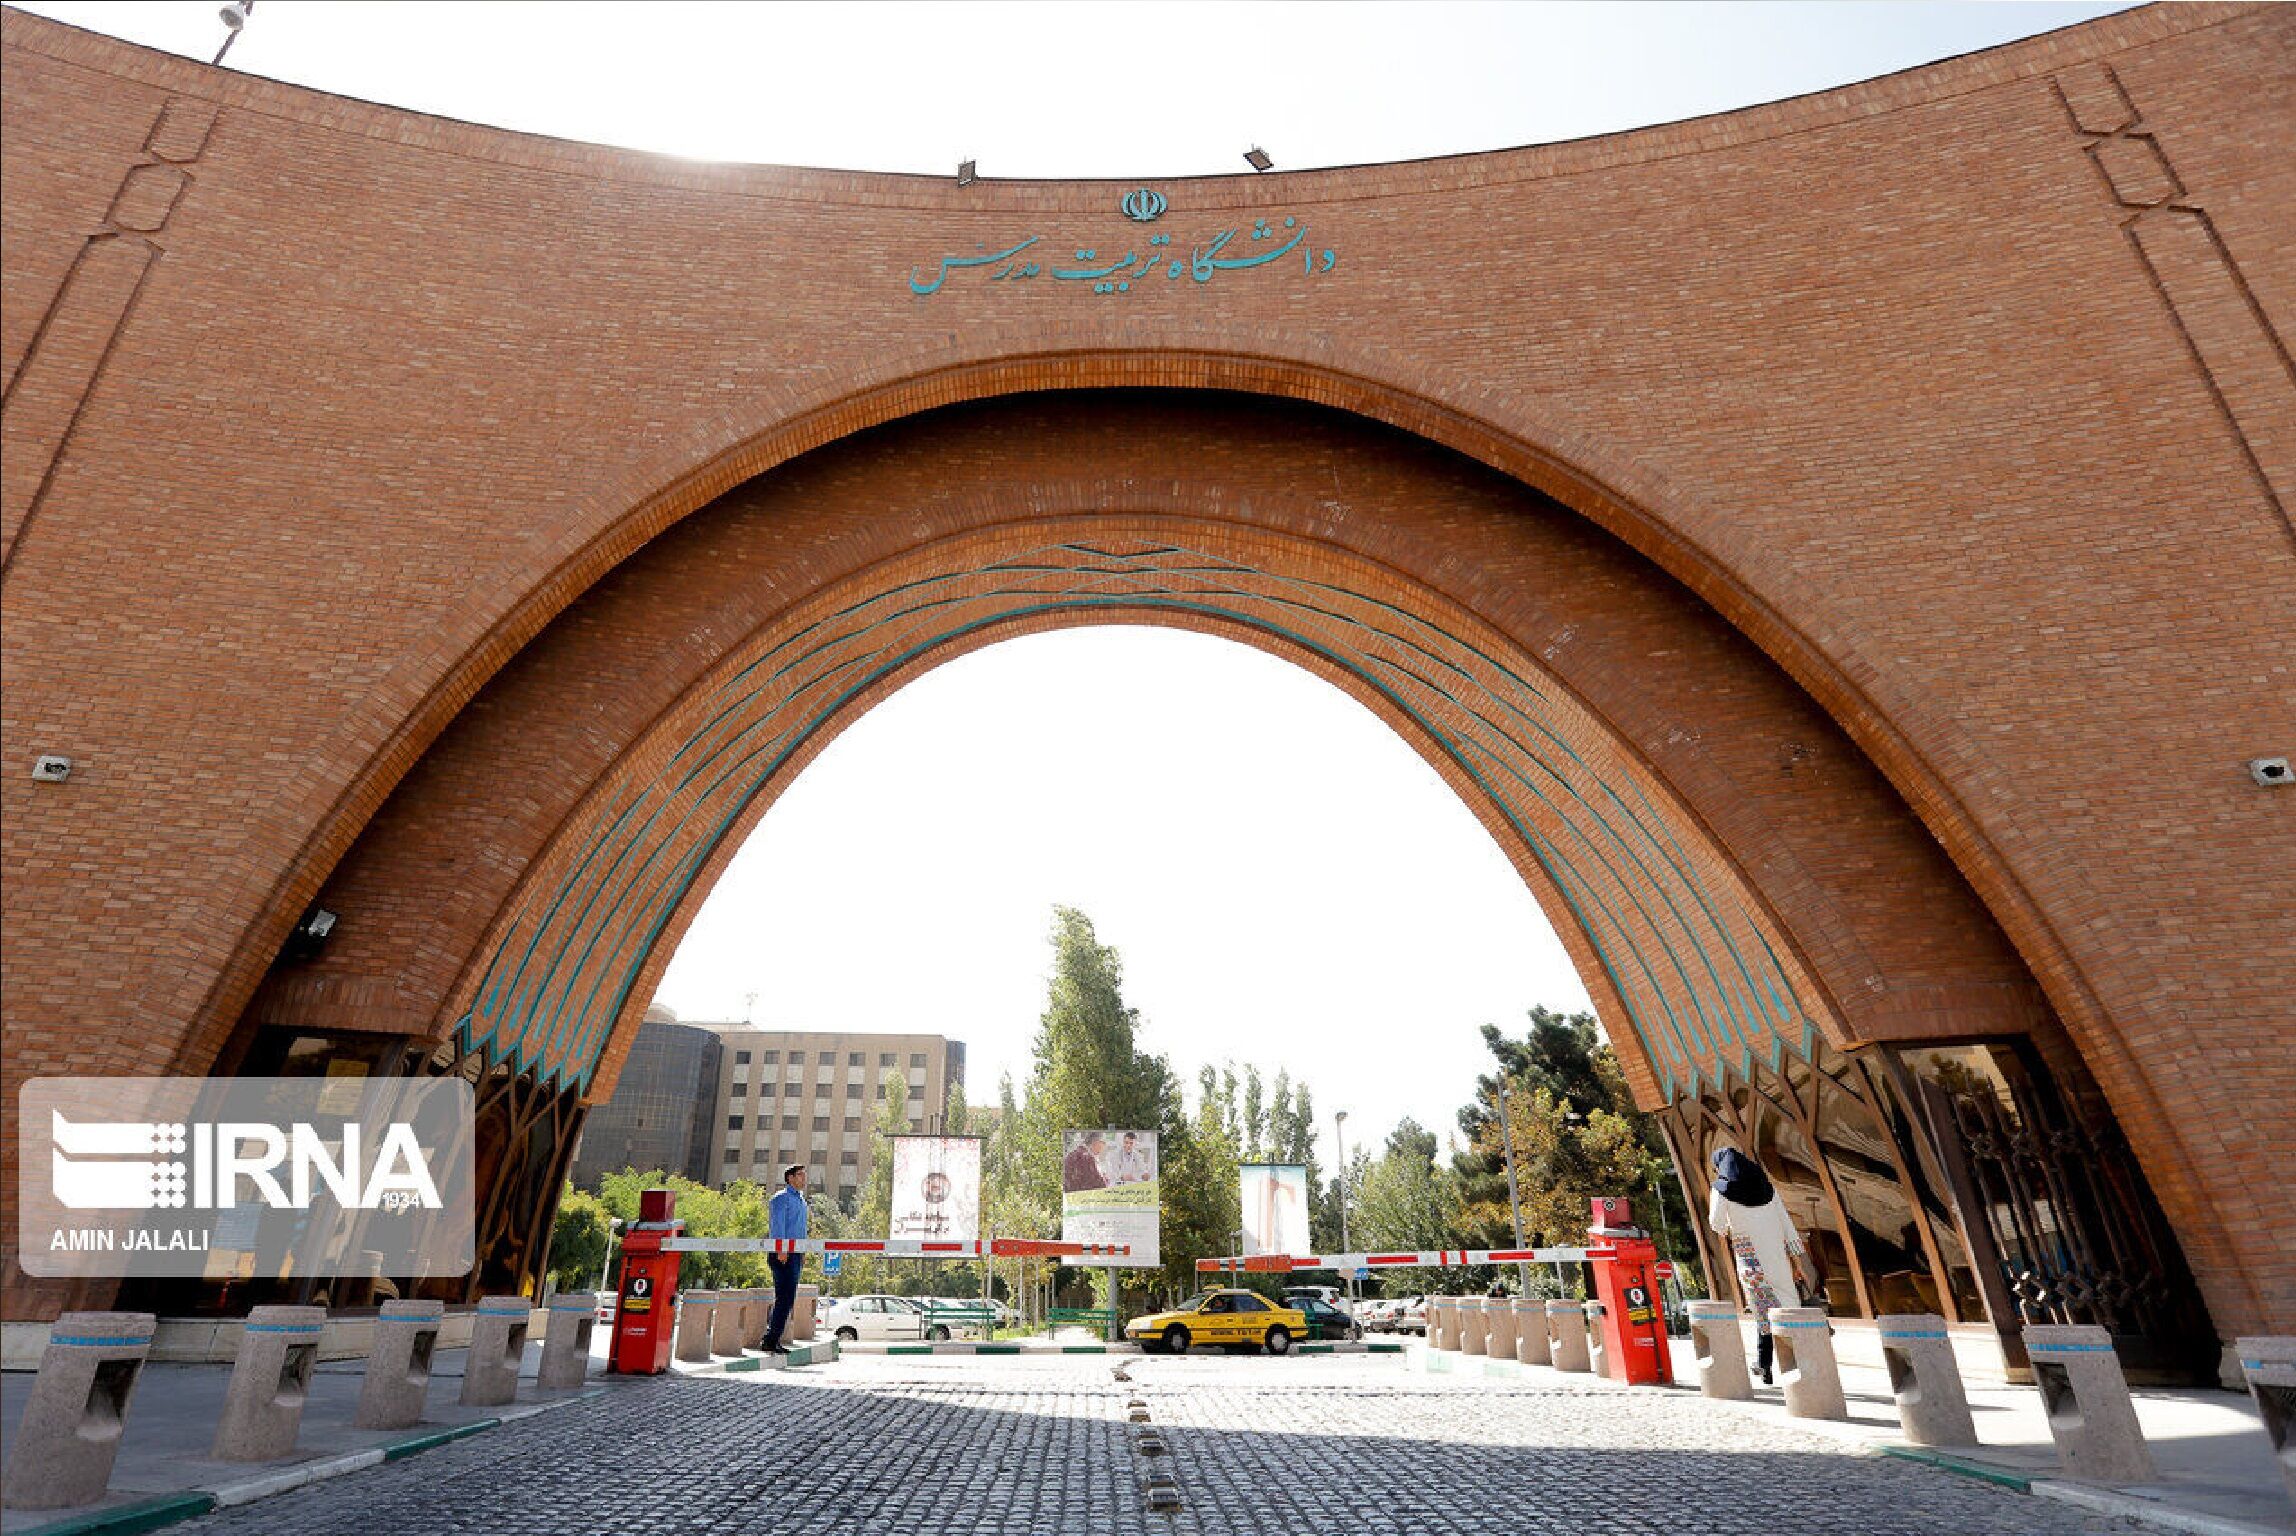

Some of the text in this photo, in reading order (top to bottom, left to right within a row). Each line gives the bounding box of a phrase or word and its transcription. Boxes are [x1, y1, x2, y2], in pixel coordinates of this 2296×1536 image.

[908, 217, 1336, 295] دانشگاه تربیت مدرس
[828, 1251, 839, 1265] P
